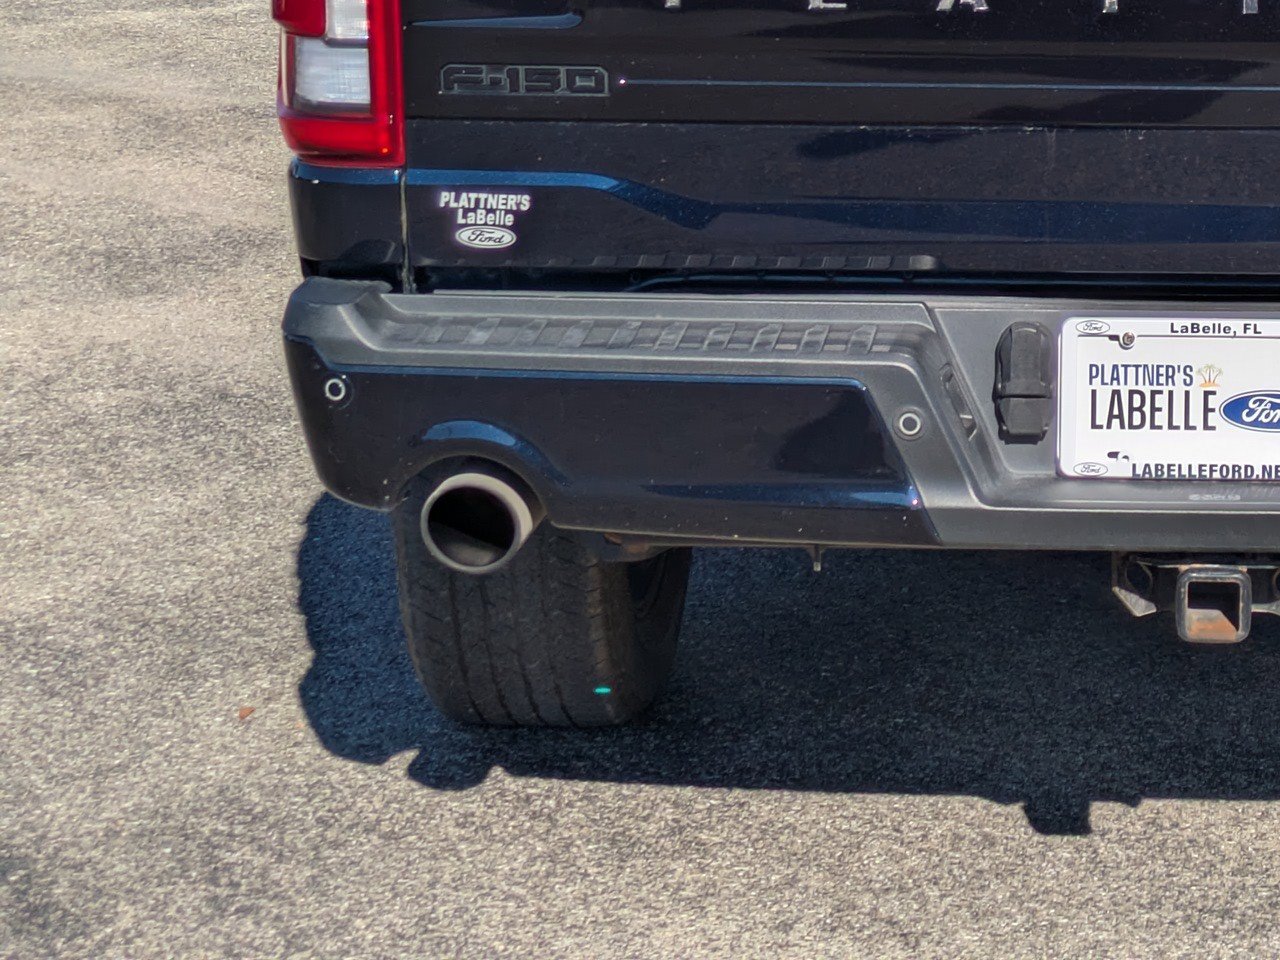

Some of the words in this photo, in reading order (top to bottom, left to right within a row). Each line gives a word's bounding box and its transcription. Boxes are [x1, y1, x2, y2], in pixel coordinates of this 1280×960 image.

[439, 191, 531, 211] PLATTNER'S
[457, 208, 515, 227] LaBelle
[467, 229, 505, 244] Ford
[1169, 322, 1237, 338] LaBelle,
[1243, 323, 1262, 335] FL
[1088, 363, 1194, 387] PLATTNER'S
[1090, 389, 1217, 431] LABELLE
